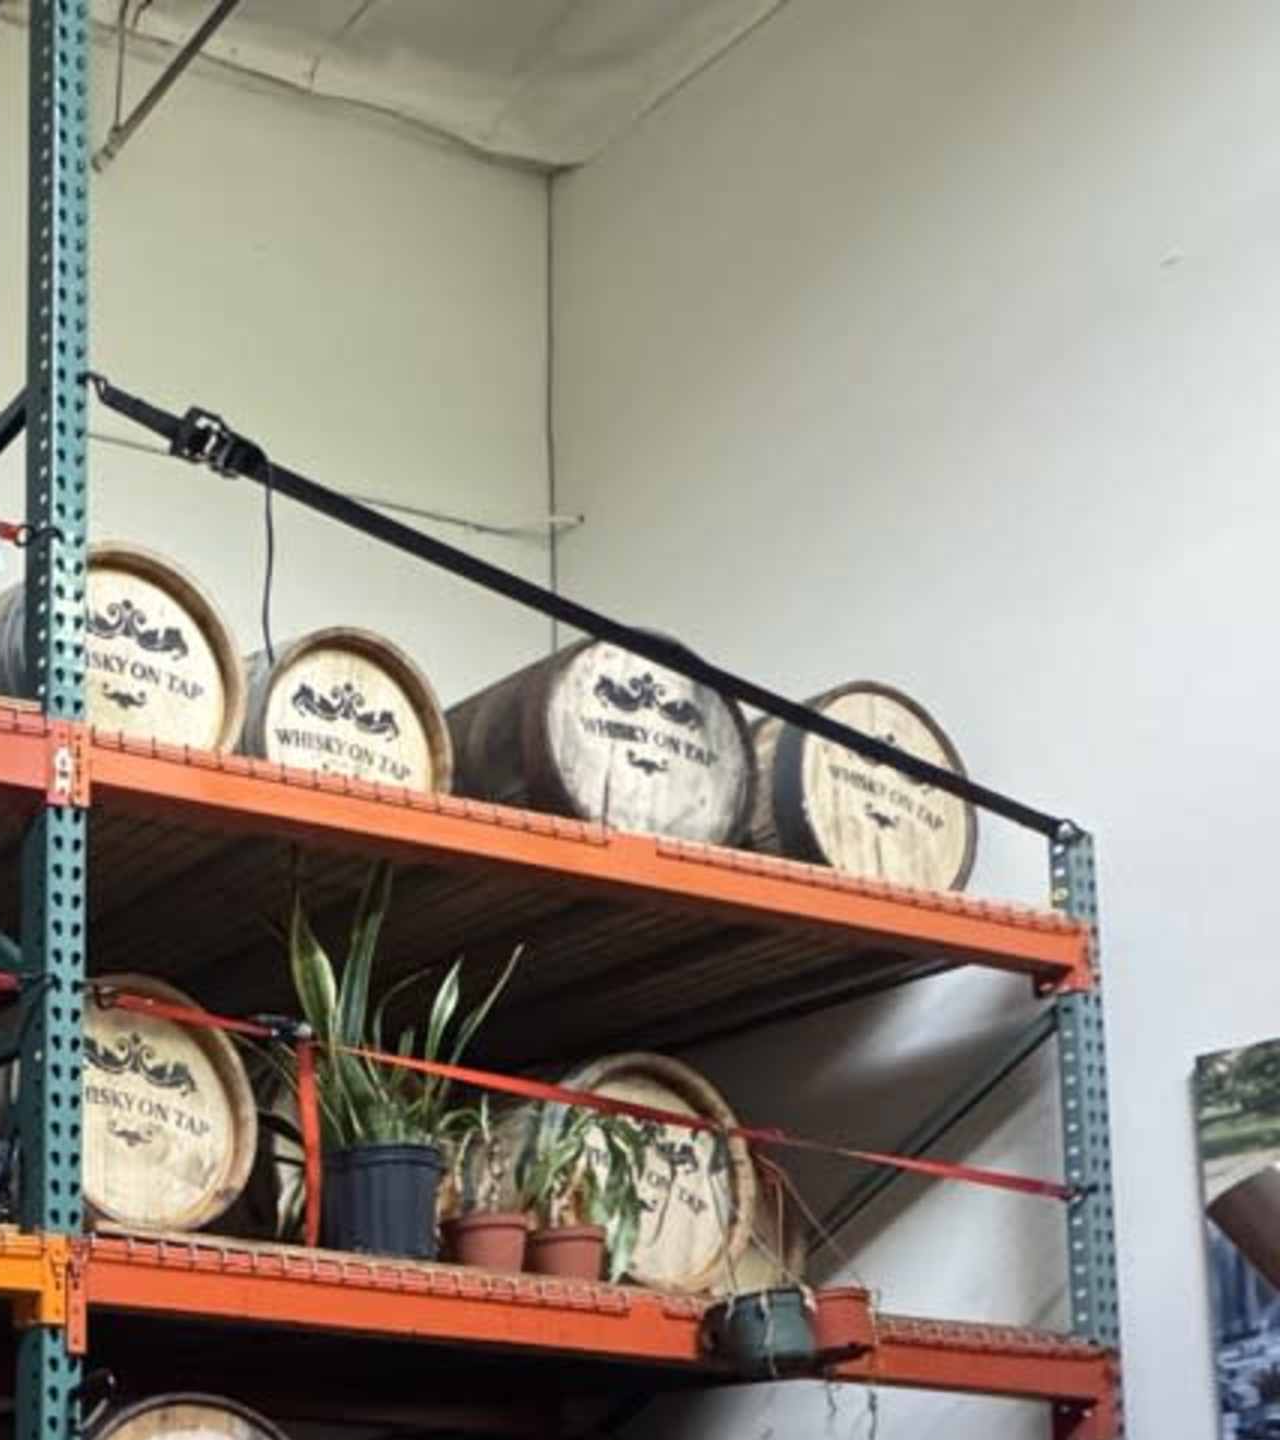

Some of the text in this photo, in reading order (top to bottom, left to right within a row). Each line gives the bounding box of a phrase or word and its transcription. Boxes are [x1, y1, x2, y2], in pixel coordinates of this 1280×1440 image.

[130, 660, 159, 685] ON
[166, 671, 203, 699] TAP
[274, 728, 411, 780] WHISKY ON TAP
[579, 714, 718, 768] WHISKY ON TAP
[137, 1099, 168, 1122] ON
[173, 1108, 210, 1137] TAP
